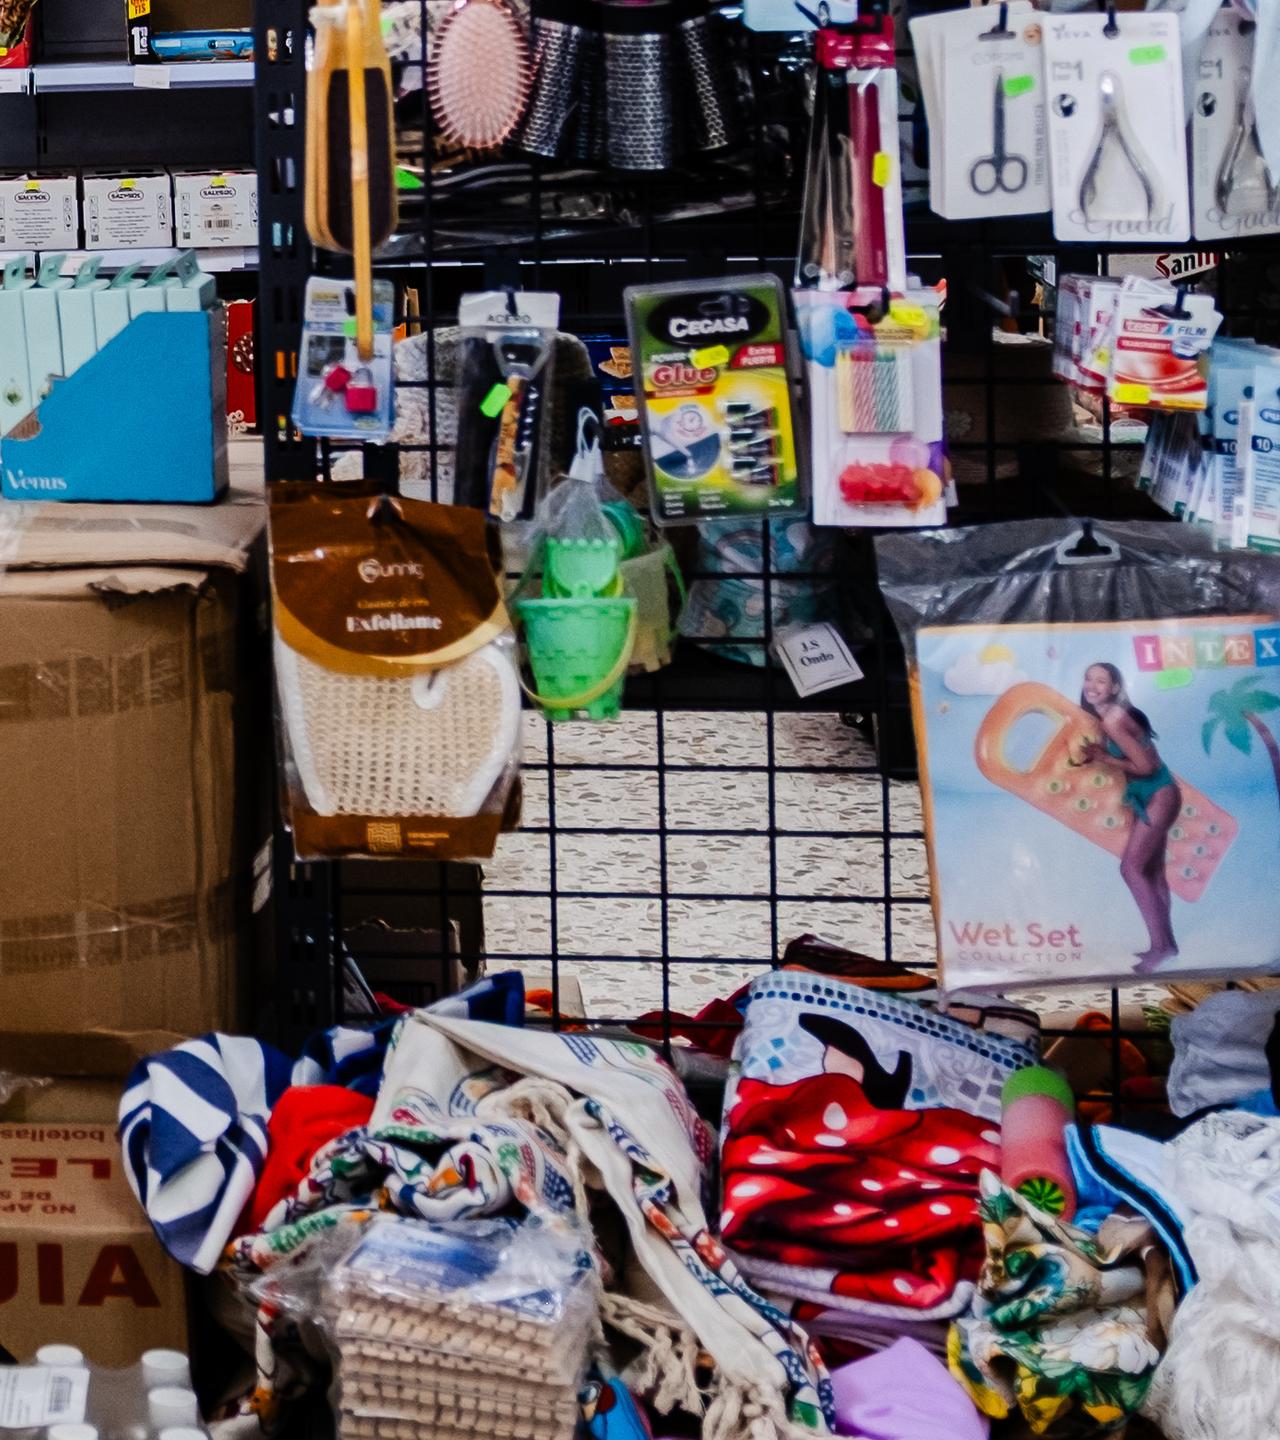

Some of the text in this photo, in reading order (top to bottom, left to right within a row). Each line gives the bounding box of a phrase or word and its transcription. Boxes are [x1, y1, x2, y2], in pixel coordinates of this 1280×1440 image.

[668, 317, 750, 339] CEGASA
[1177, 325, 1208, 337] FILM
[747, 346, 776, 356] Extra
[651, 364, 717, 386] Glue
[1255, 438, 1271, 452] 10
[5, 469, 68, 491] Venus
[346, 612, 443, 633] Exfoliante
[1138, 636, 1280, 666] INTEX
[947, 922, 1083, 950] Wet Set
[956, 950, 1085, 965] COLLECTION
[0, 1125, 106, 1143] botellas
[21, 1189, 52, 1201] DE
[40, 1202, 77, 1215] NO
